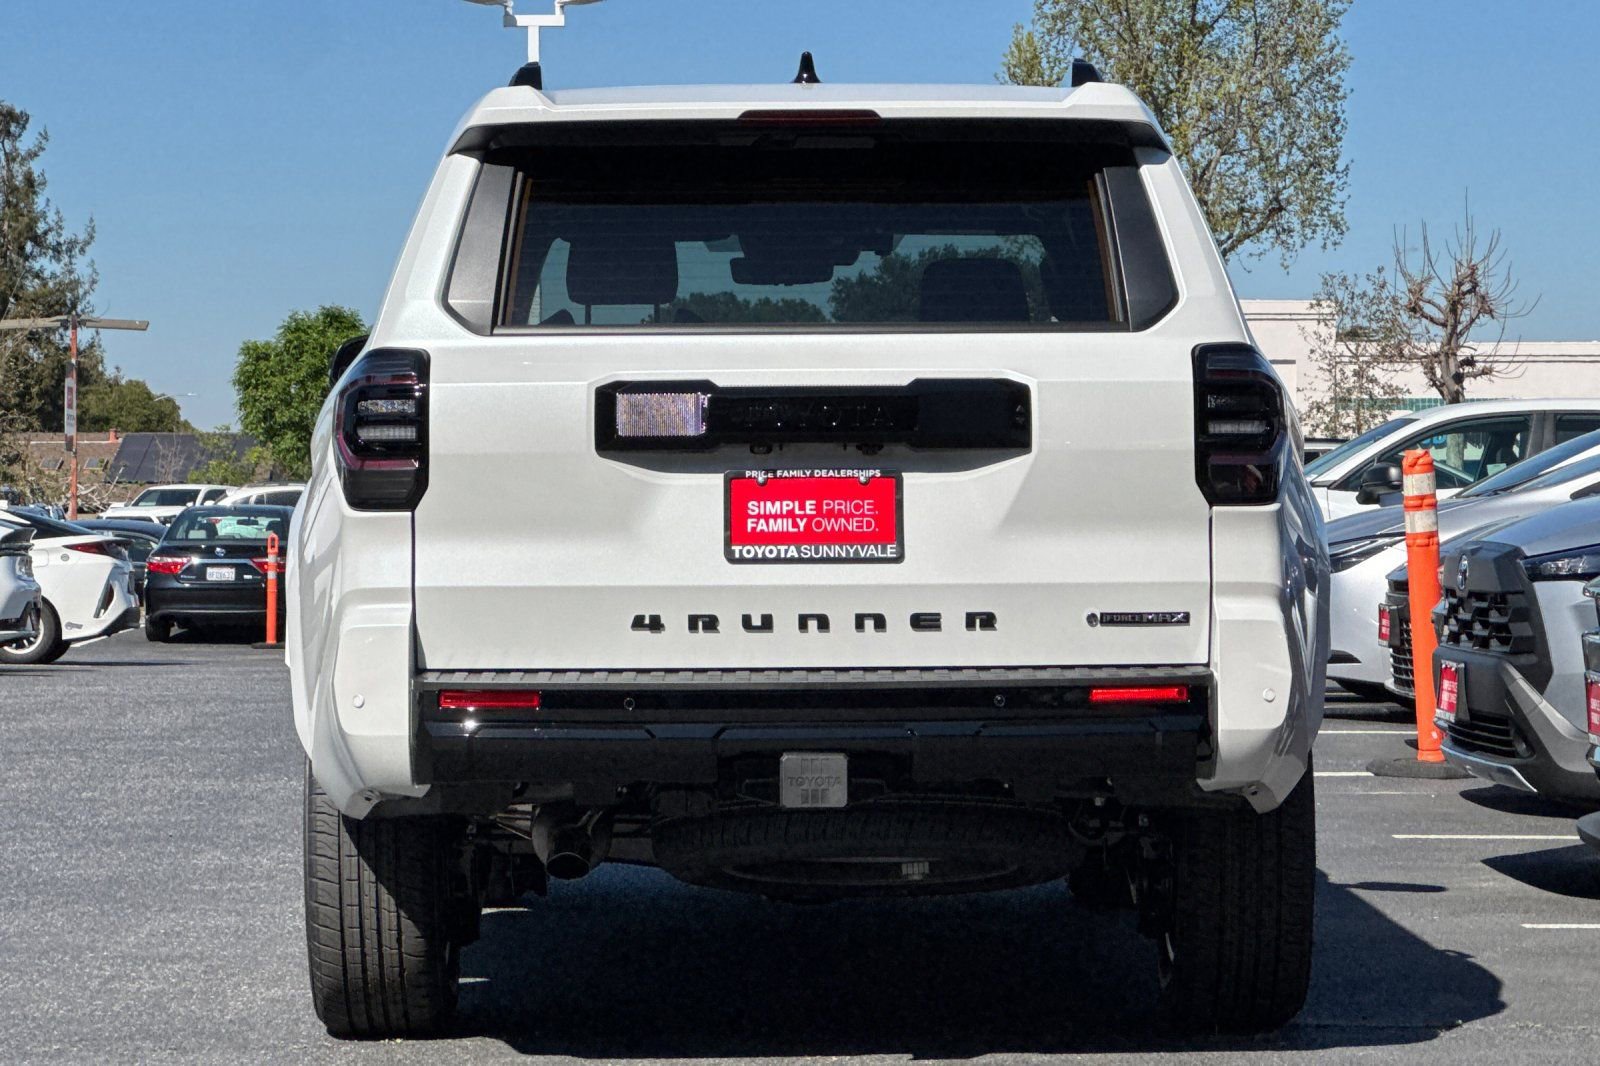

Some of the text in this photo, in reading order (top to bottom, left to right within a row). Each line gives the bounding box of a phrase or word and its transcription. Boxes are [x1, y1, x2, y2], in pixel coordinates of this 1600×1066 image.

[745, 469, 881, 478] PRICE FAMILY DEALERSHIPS
[747, 500, 879, 515] SIMPLE PRICE.
[747, 517, 879, 533] FAMILY OWNED.
[731, 544, 897, 559] TOYOTA SUNNYVALE
[630, 611, 998, 633] 4RUNNER
[1142, 613, 1187, 623] MAX
[786, 775, 842, 788] TOYOTA
